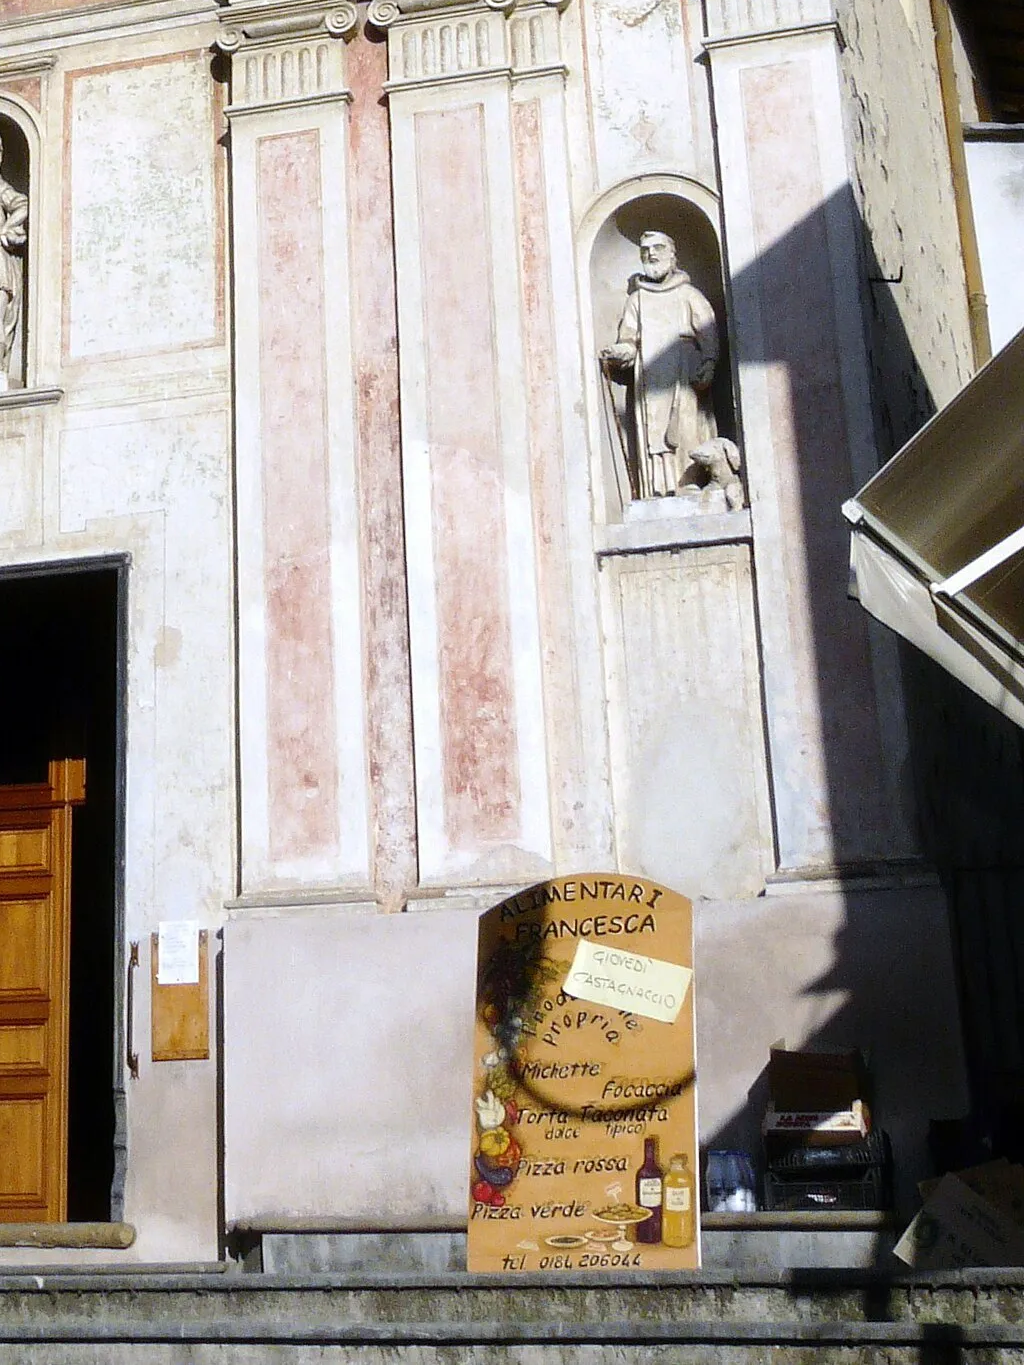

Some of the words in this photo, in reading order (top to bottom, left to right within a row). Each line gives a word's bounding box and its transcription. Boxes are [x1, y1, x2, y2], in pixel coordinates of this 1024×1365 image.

[500, 881, 663, 921] ALIMENTARI
[516, 914, 655, 944] FRANCESCA
[522, 1062, 599, 1079] Michette
[602, 1080, 682, 1099] Focaccia
[516, 1108, 568, 1125] Torta
[516, 1160, 565, 1176] Pizza
[573, 1158, 627, 1173] rossa
[471, 1204, 521, 1220] Pizza
[531, 1200, 585, 1218] verde
[539, 1255, 573, 1270] 0184
[579, 1253, 641, 1268] 206044
